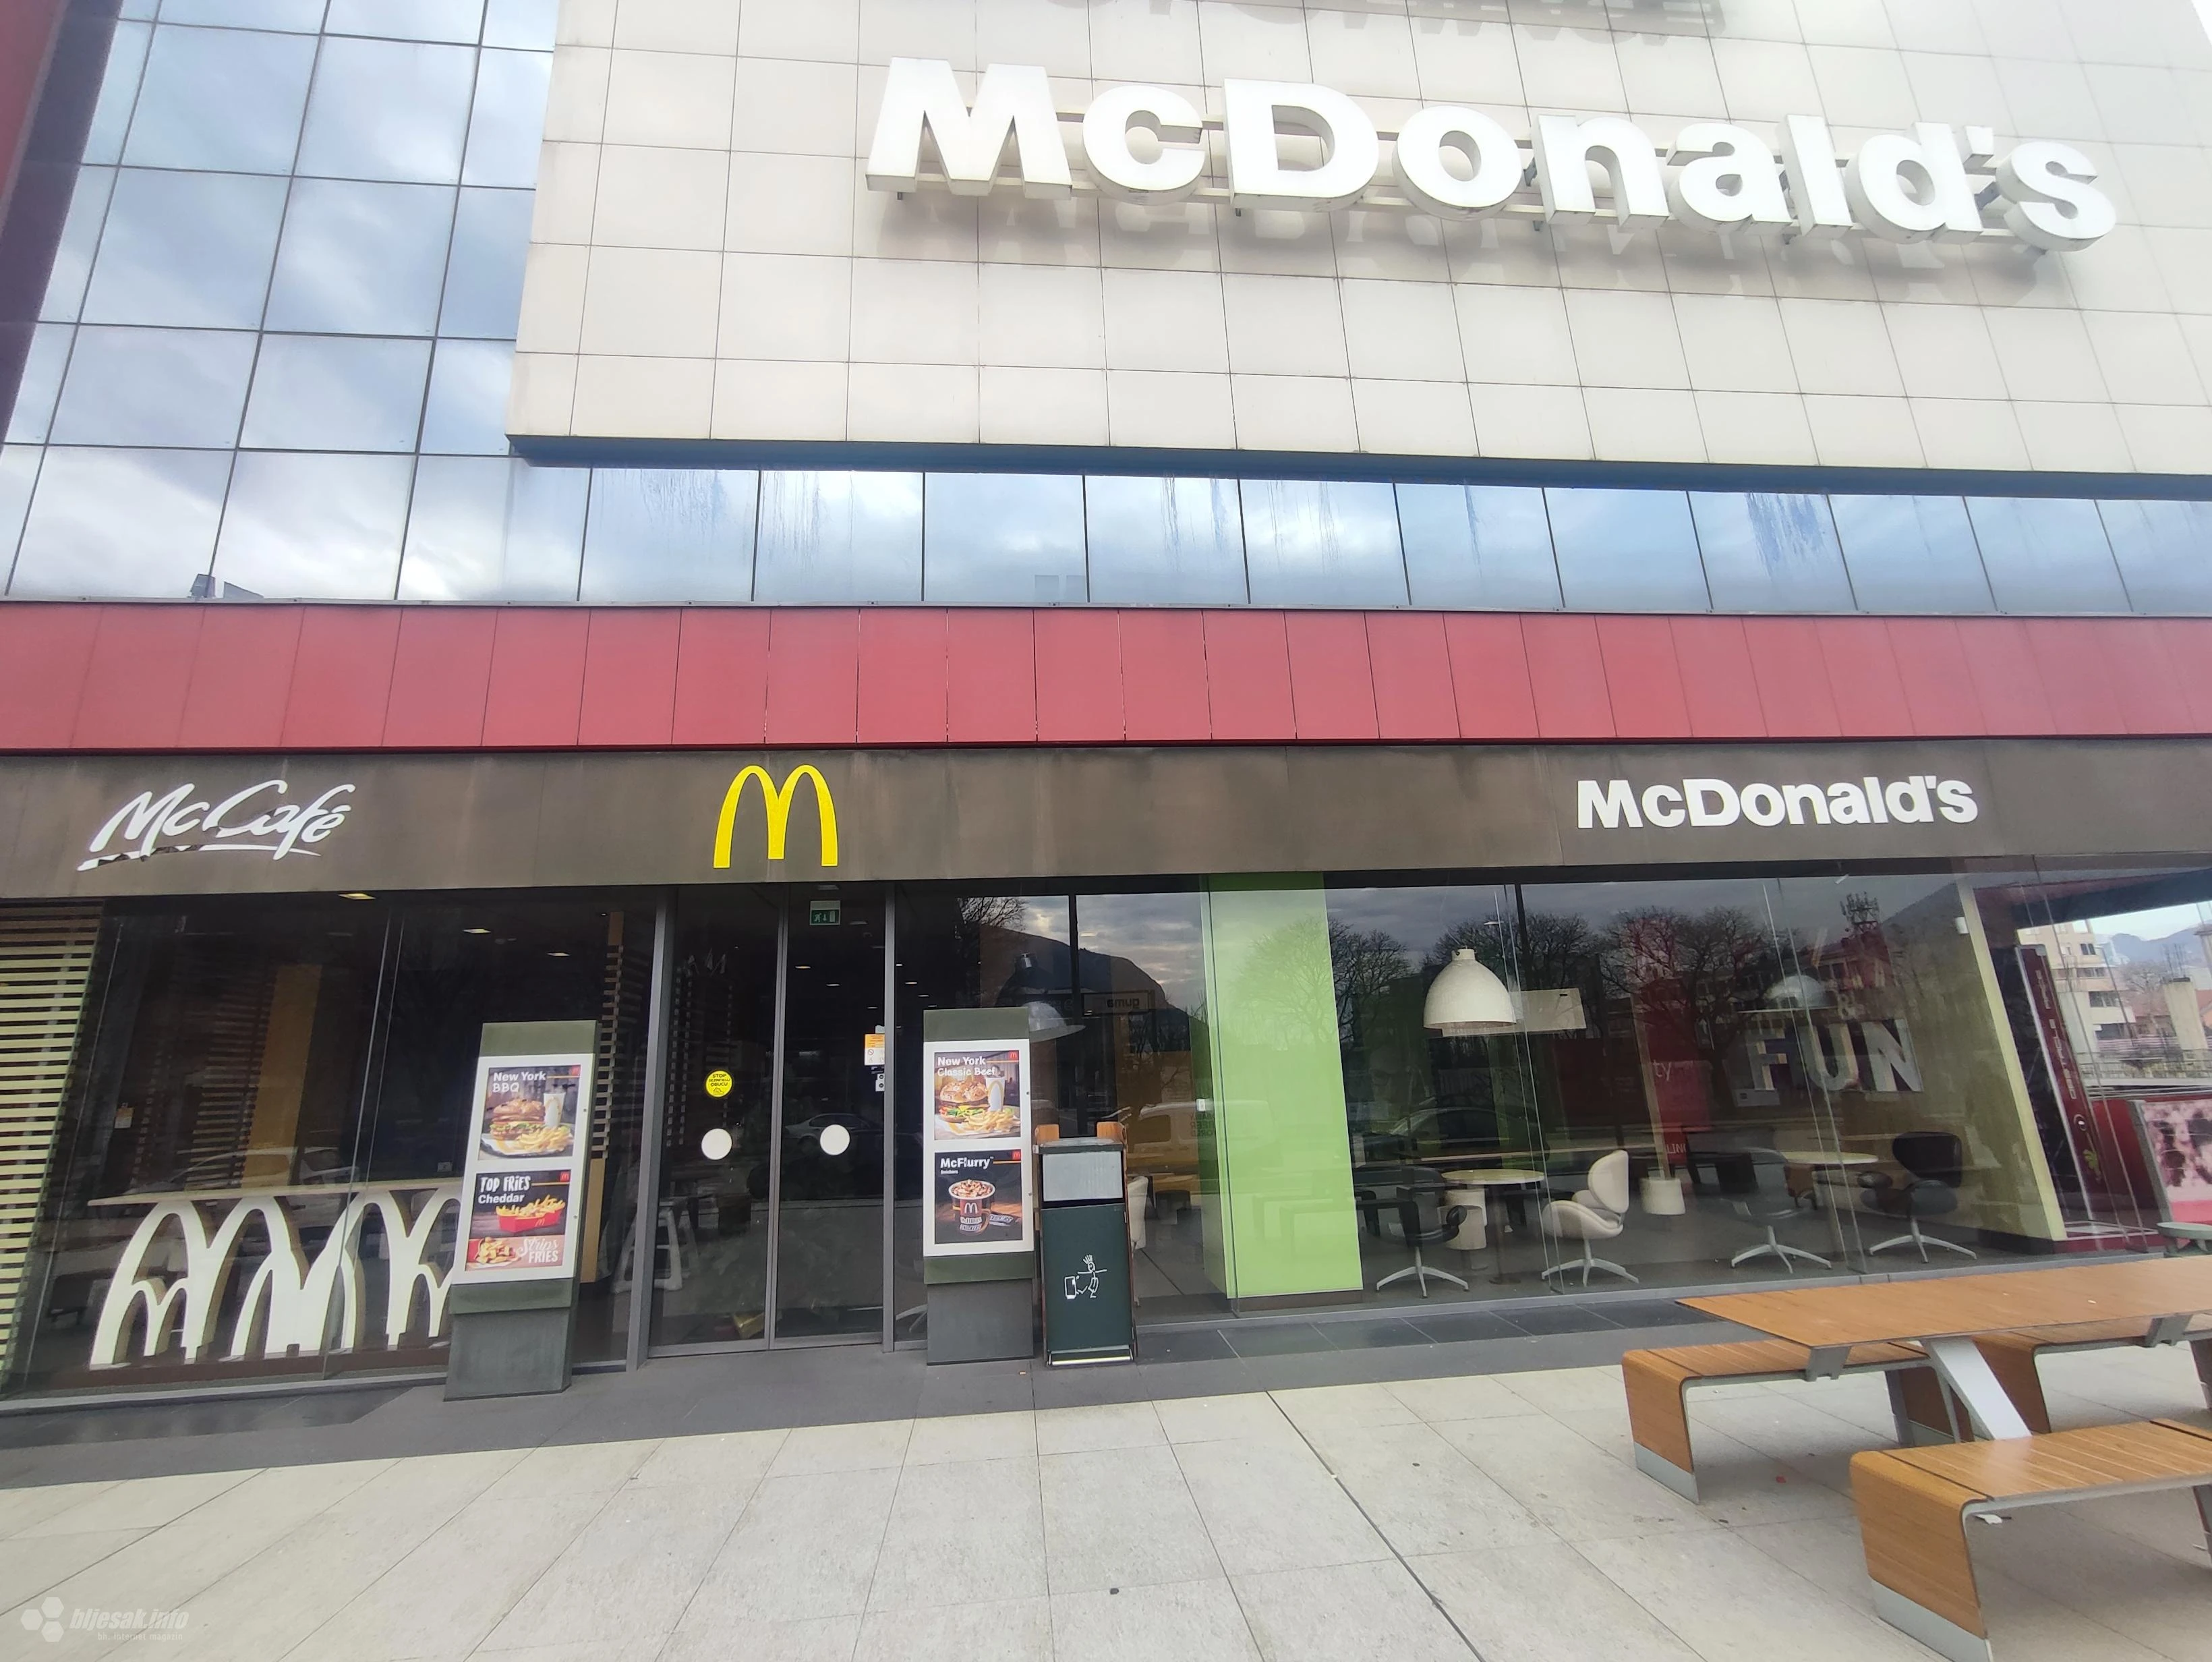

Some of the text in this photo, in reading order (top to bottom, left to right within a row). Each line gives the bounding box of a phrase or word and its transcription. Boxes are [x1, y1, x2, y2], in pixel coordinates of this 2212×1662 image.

[865, 57, 2118, 254] McDonald's
[1577, 775, 1979, 829] McDonald's
[86, 779, 356, 863] McCafé
[937, 1056, 986, 1066] New York
[1746, 1019, 1921, 1092] FUN
[493, 1070, 546, 1082] New York
[937, 1066, 995, 1077] Classic Beef
[492, 1082, 520, 1093] BBQ
[480, 1176, 500, 1193] TOP
[477, 1193, 525, 1204] Cheddar
[528, 1250, 559, 1263] FRIES
